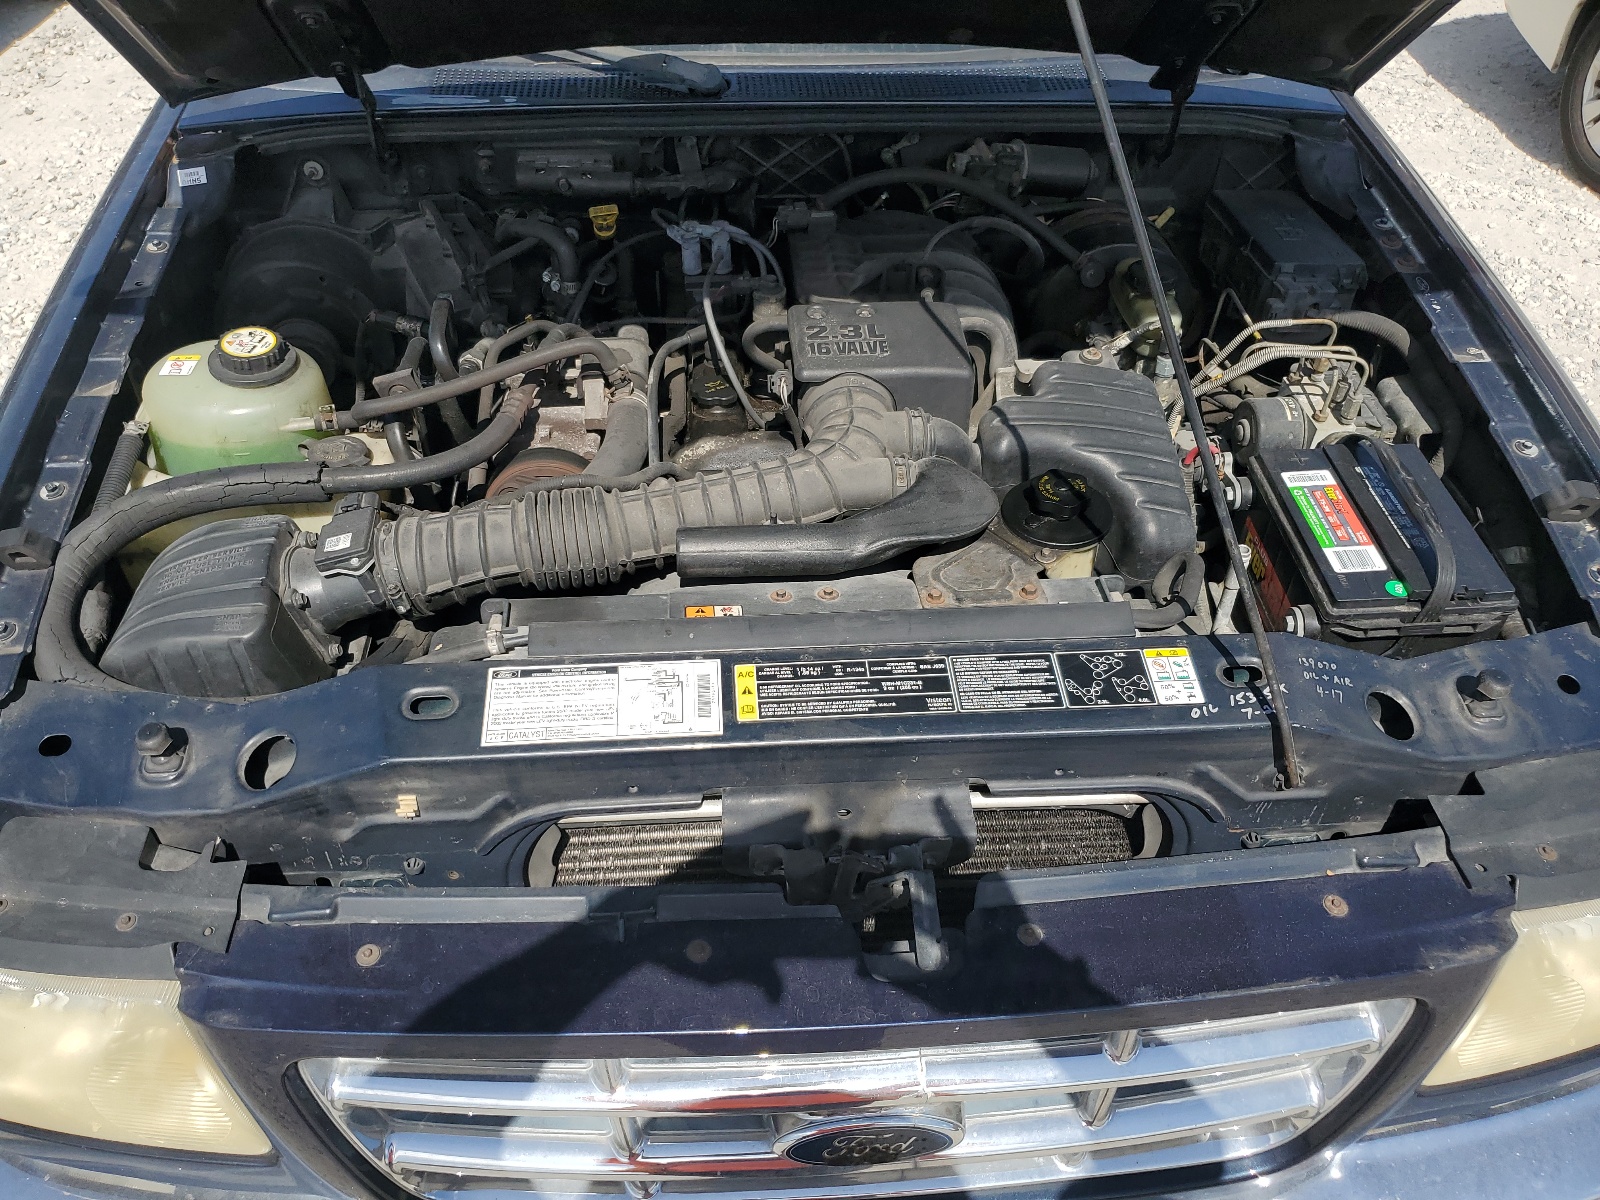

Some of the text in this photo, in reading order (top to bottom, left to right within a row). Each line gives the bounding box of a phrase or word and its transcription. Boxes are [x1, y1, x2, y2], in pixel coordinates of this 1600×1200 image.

[804, 323, 887, 341] 2.3L
[807, 340, 890, 357] 16 VALVE
[1303, 671, 1319, 680] OIL
[1333, 675, 1353, 687] AIR
[1316, 684, 1342, 704] 4-17
[1190, 703, 1219, 719] OIL
[508, 730, 546, 740] CATALYST
[821, 1132, 919, 1159] Ford
